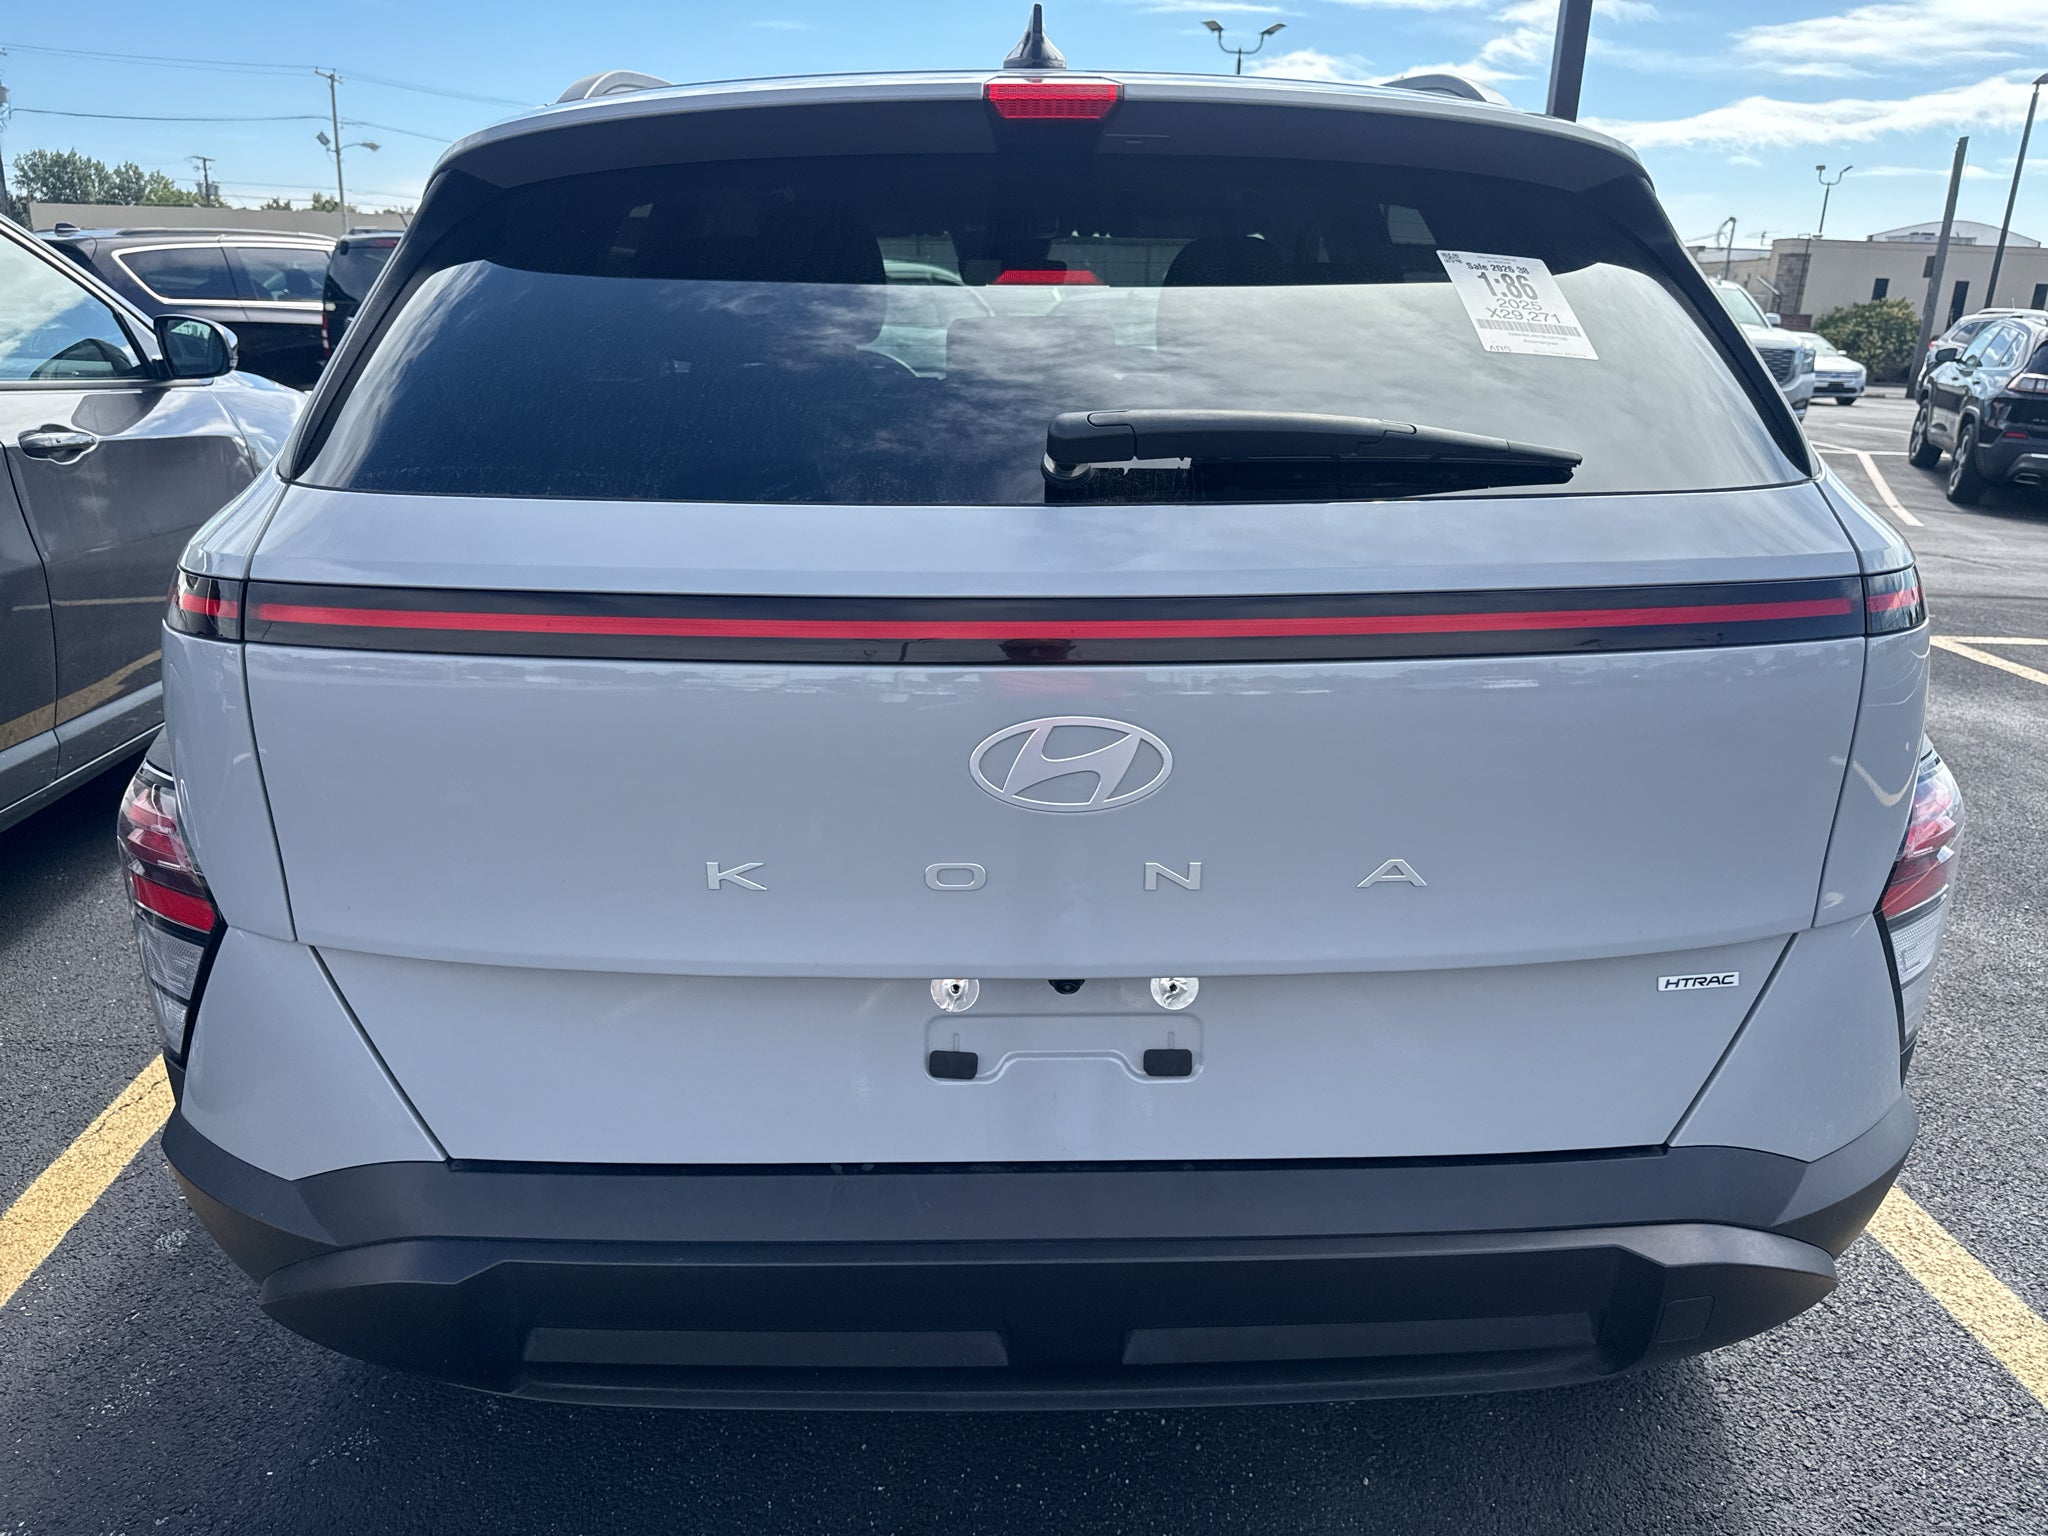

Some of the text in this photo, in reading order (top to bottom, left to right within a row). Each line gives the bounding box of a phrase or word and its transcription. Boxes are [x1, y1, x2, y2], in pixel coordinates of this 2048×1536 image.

[1466, 262, 1488, 271] Sale
[1490, 263, 1515, 273] 2026
[1477, 271, 1538, 300] 1:86
[1496, 298, 1542, 311] 2025
[1486, 307, 1560, 323] X29,271
[705, 858, 1428, 892] KONA
[1664, 974, 1735, 989] HTRAC
